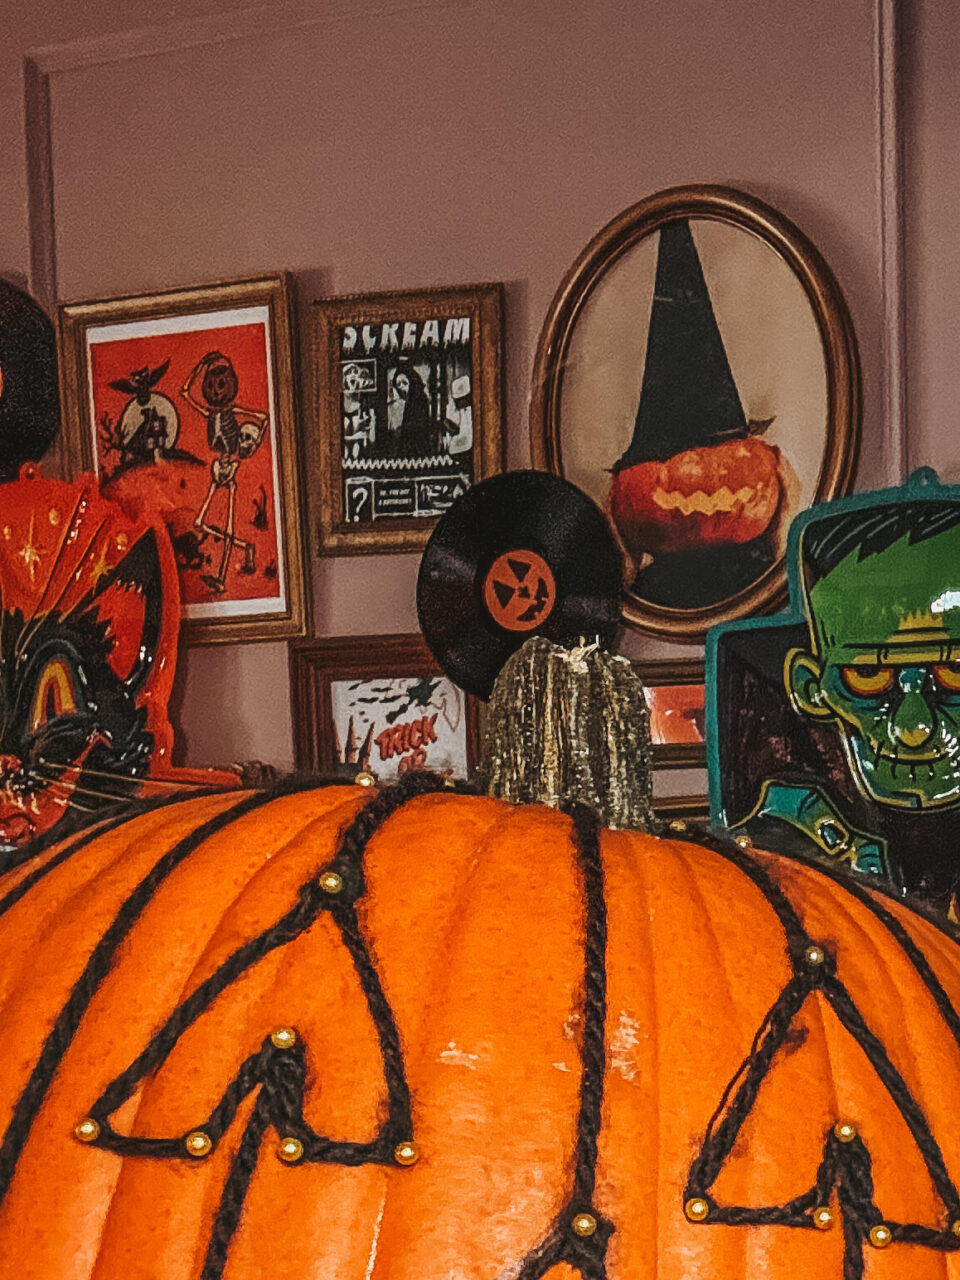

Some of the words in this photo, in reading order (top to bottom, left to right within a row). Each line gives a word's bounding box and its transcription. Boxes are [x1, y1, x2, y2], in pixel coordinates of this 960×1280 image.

[342, 317, 470, 354] SCREAM
[352, 487, 368, 522] ?
[374, 713, 438, 761] TRICK
